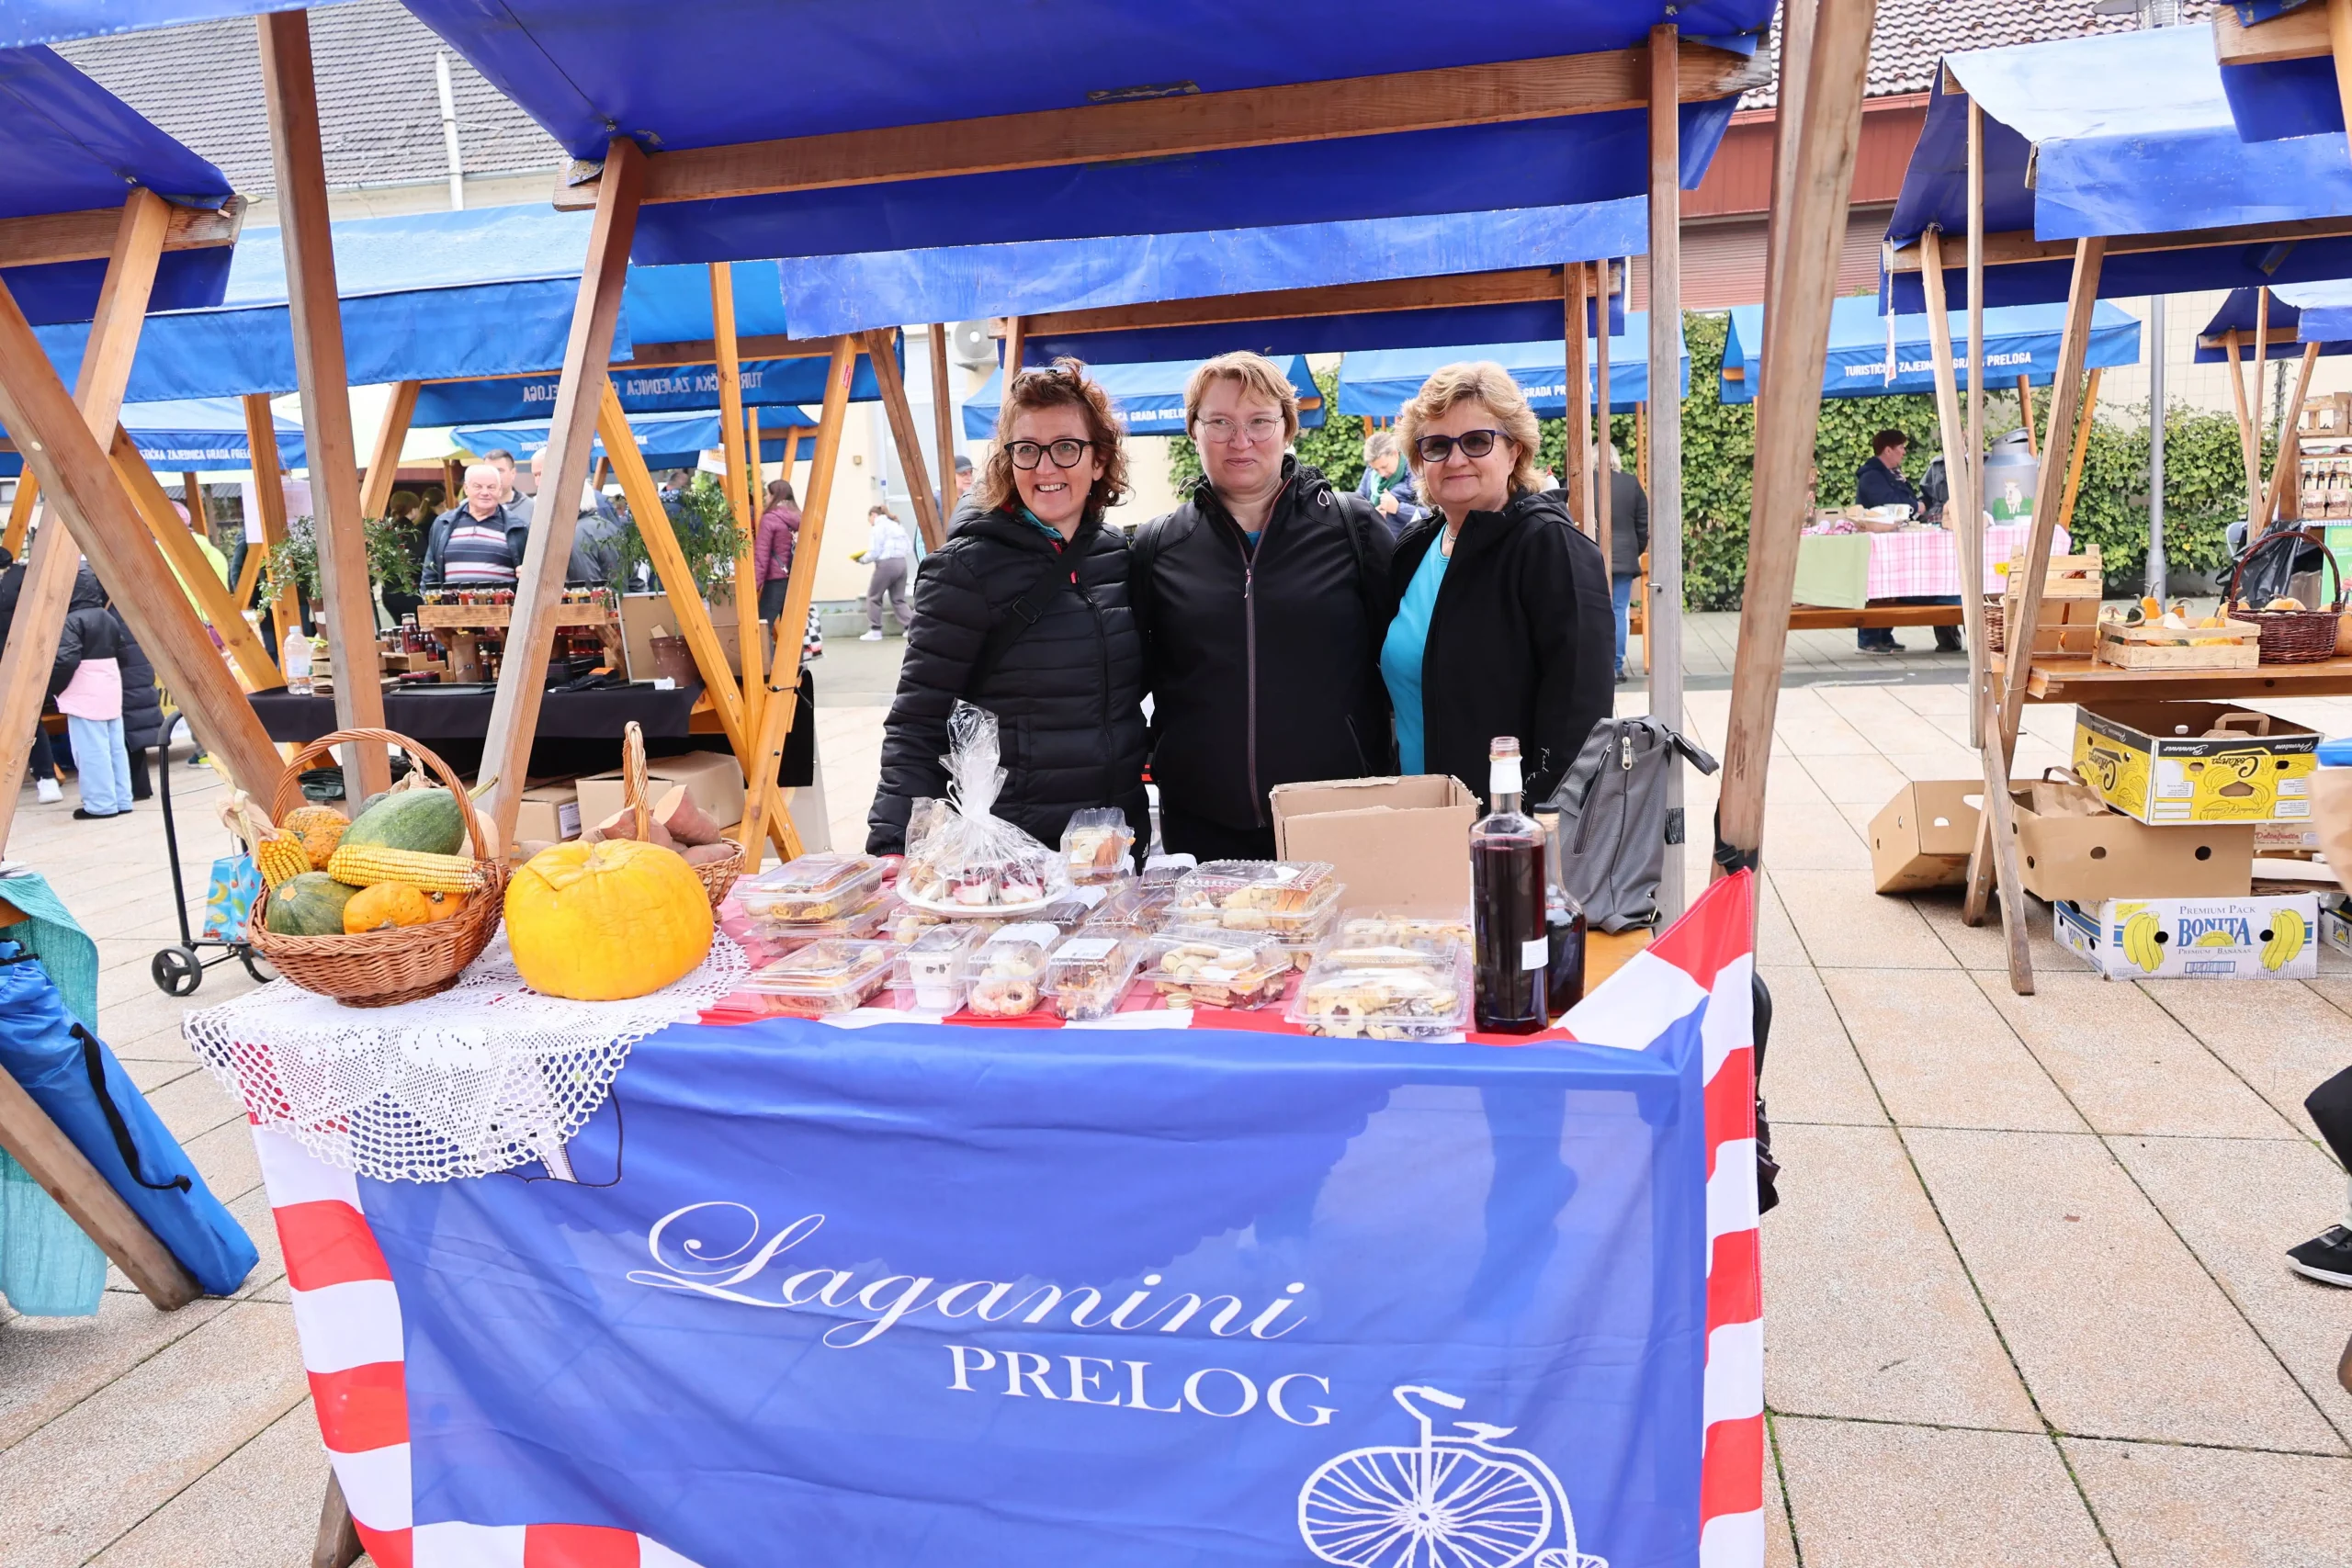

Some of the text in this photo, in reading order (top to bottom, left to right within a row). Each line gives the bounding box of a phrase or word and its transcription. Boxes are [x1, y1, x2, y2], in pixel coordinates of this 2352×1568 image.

[1844, 362, 1886, 377] TURISTIČ
[1898, 358, 1934, 372] ZAJEDN
[1987, 352, 2031, 367] PRELOGA
[2163, 739, 2313, 756] Premium Bananas
[2211, 755, 2259, 778] Costanza
[2229, 905, 2256, 914] PACK
[2176, 918, 2252, 947] BONITA
[626, 1201, 1308, 1348] Laganini
[943, 1344, 1340, 1427] PRELOG
